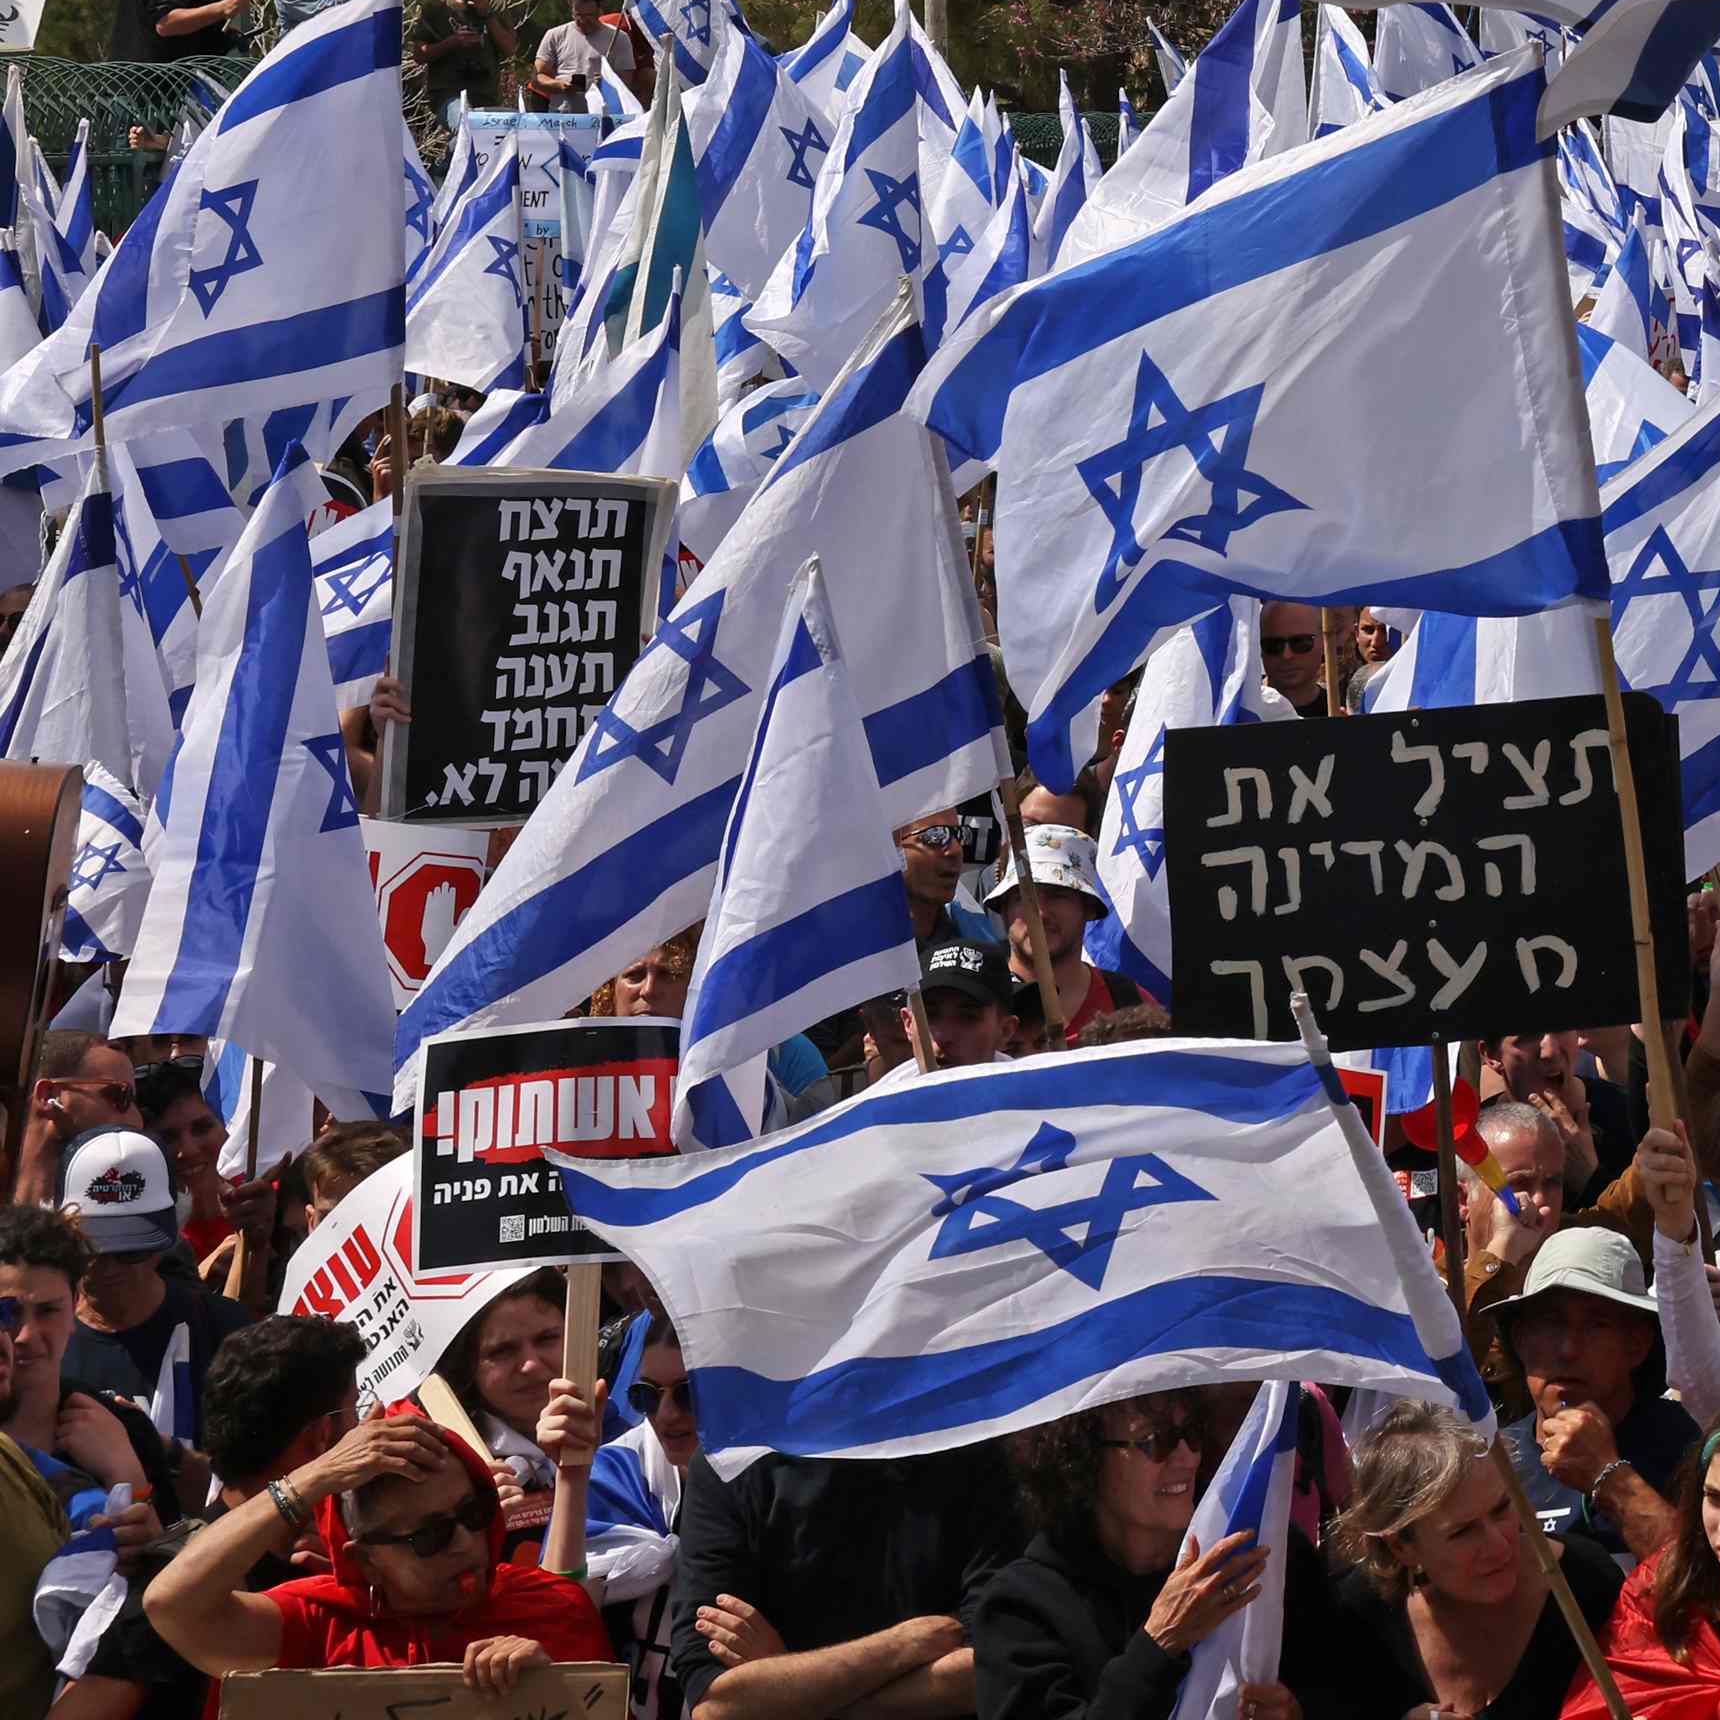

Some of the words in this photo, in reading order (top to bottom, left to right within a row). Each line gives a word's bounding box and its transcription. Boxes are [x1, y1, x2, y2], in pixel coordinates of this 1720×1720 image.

[538, 117, 577, 128] Mach
[499, 497, 629, 542] תרצח
[501, 548, 623, 600] תנאף
[509, 599, 617, 647] תגנב
[495, 651, 615, 700] תענה
[1206, 753, 1336, 828] את
[1391, 728, 1620, 817] תציל
[1200, 833, 1537, 921] המדינה
[437, 1075, 656, 1164] אשתוק!
[433, 1178, 492, 1206] פניה
[498, 1171, 540, 1199] את
[374, 1277, 398, 1313] את
